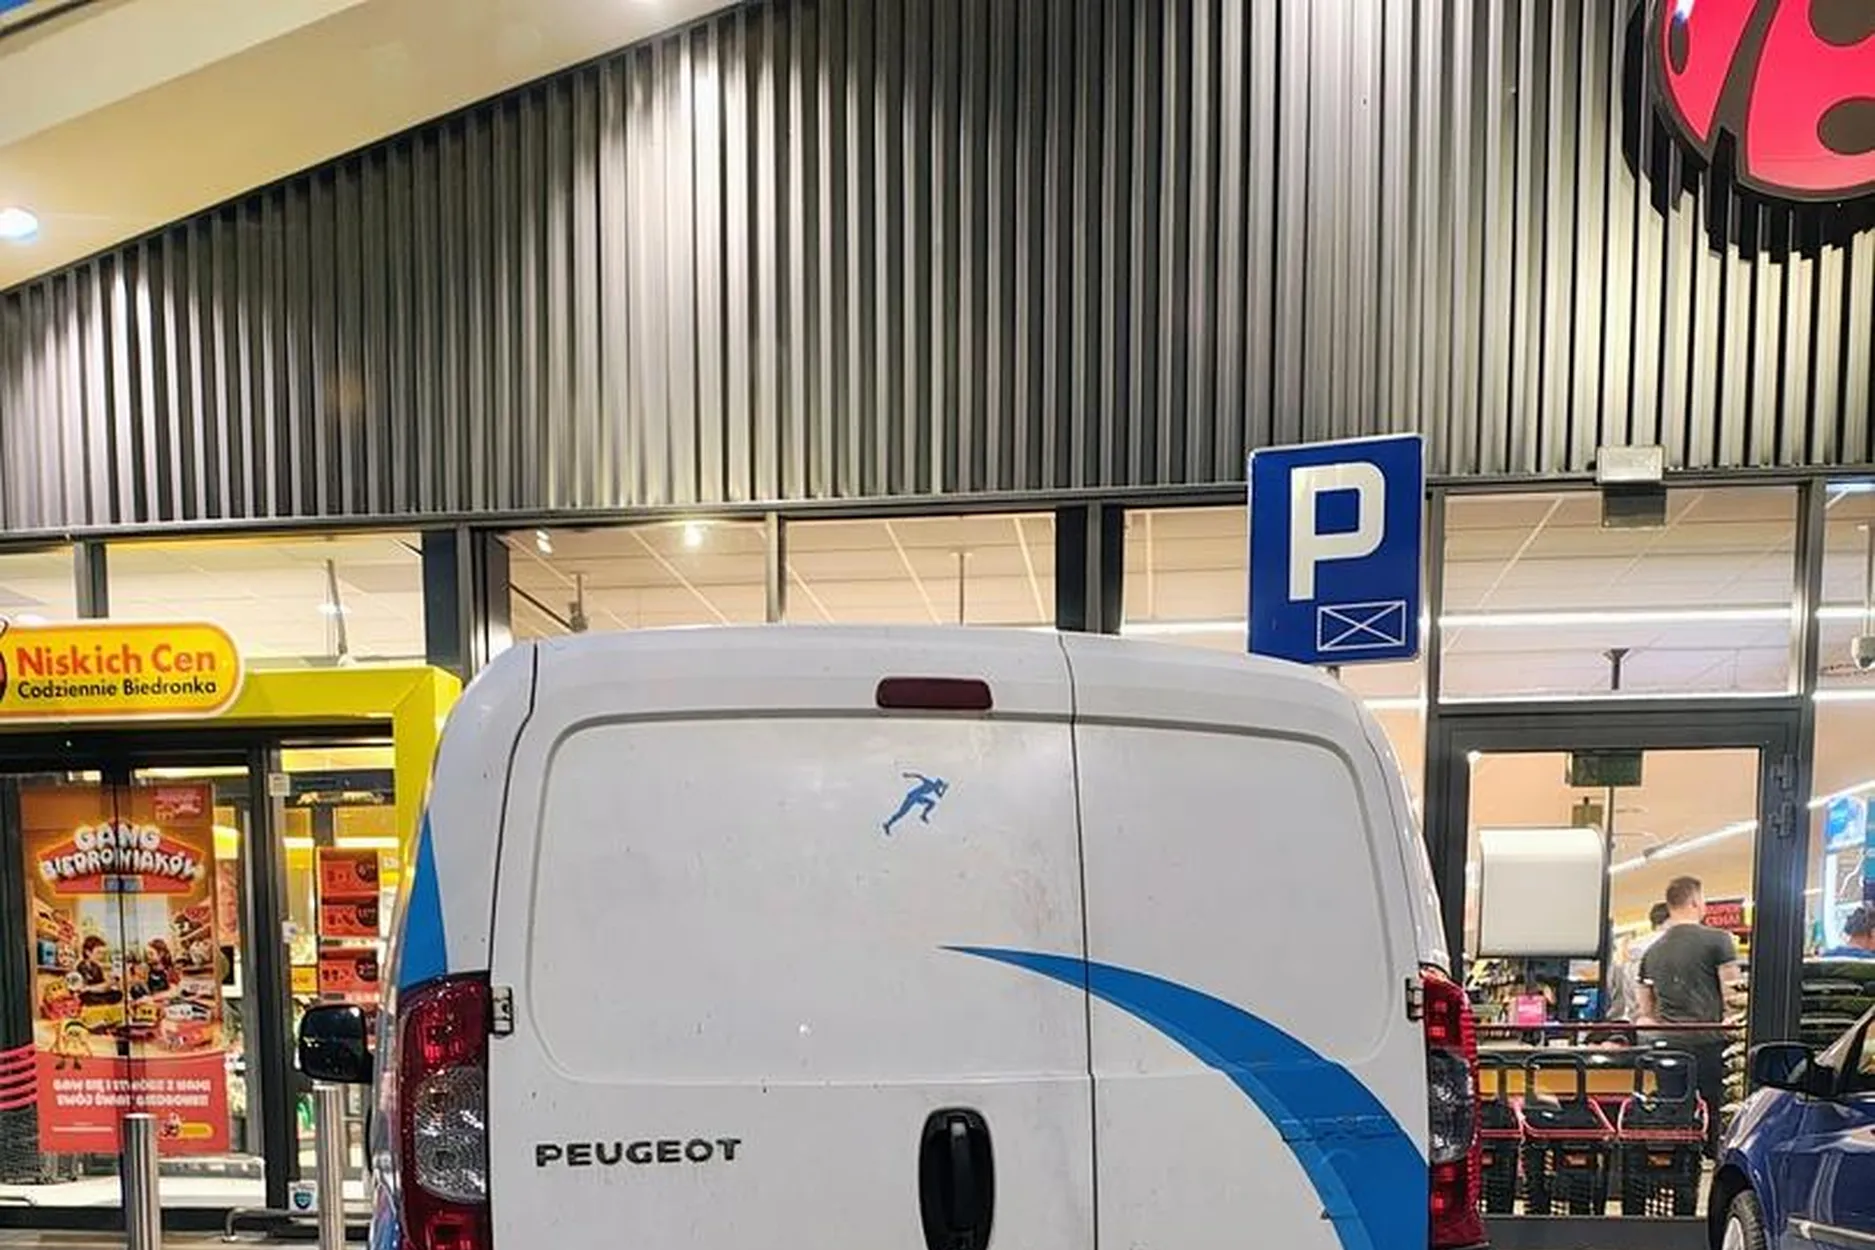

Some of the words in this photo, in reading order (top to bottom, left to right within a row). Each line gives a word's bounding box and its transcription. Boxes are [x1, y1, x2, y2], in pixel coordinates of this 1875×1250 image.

[1289, 461, 1385, 601] P
[16, 643, 142, 677] Niskich
[151, 643, 216, 673] Cen
[17, 679, 118, 699] Codziennie
[123, 676, 216, 696] Biedronka
[73, 822, 161, 851] GANG
[536, 1138, 742, 1167] PEUGEOT
